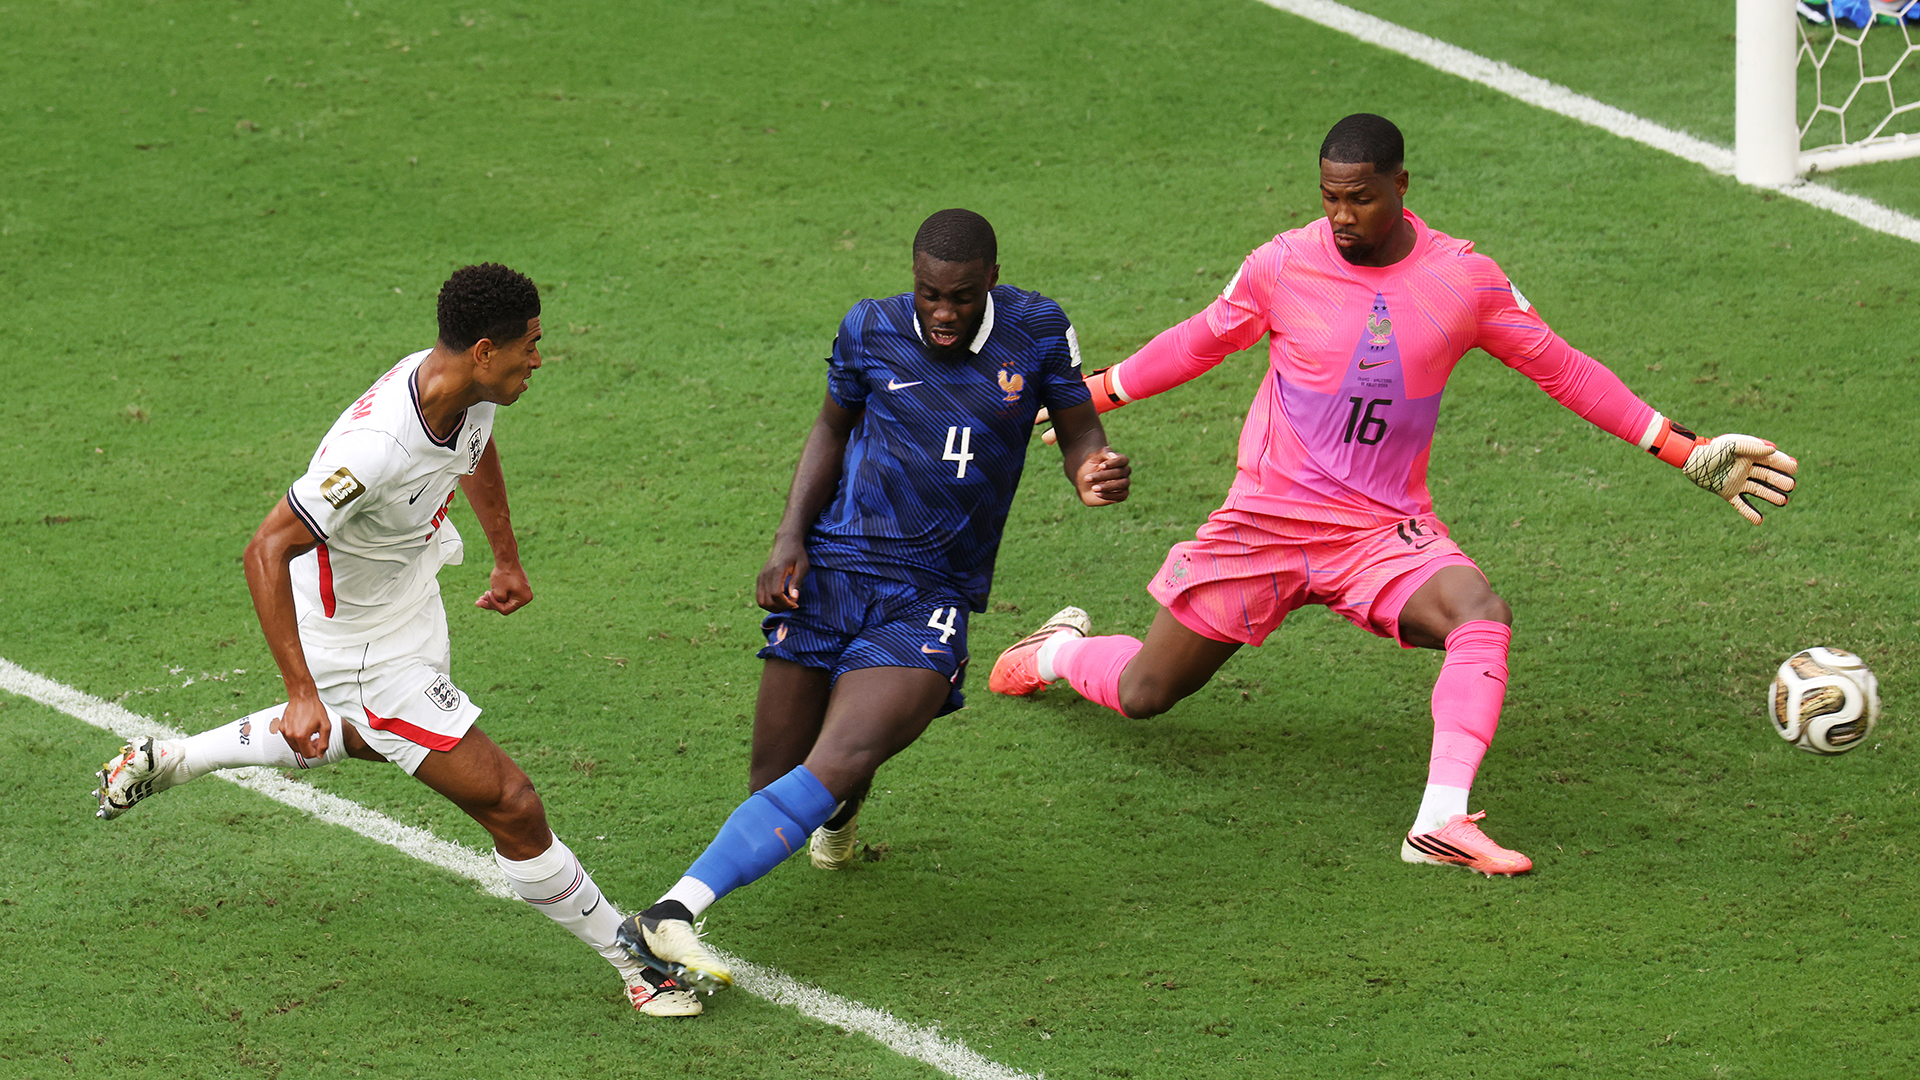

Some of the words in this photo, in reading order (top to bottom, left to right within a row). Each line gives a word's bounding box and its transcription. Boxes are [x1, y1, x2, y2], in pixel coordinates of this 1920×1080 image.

[1343, 396, 1393, 446] 16
[942, 426, 974, 479] 4
[927, 606, 958, 644] 4
